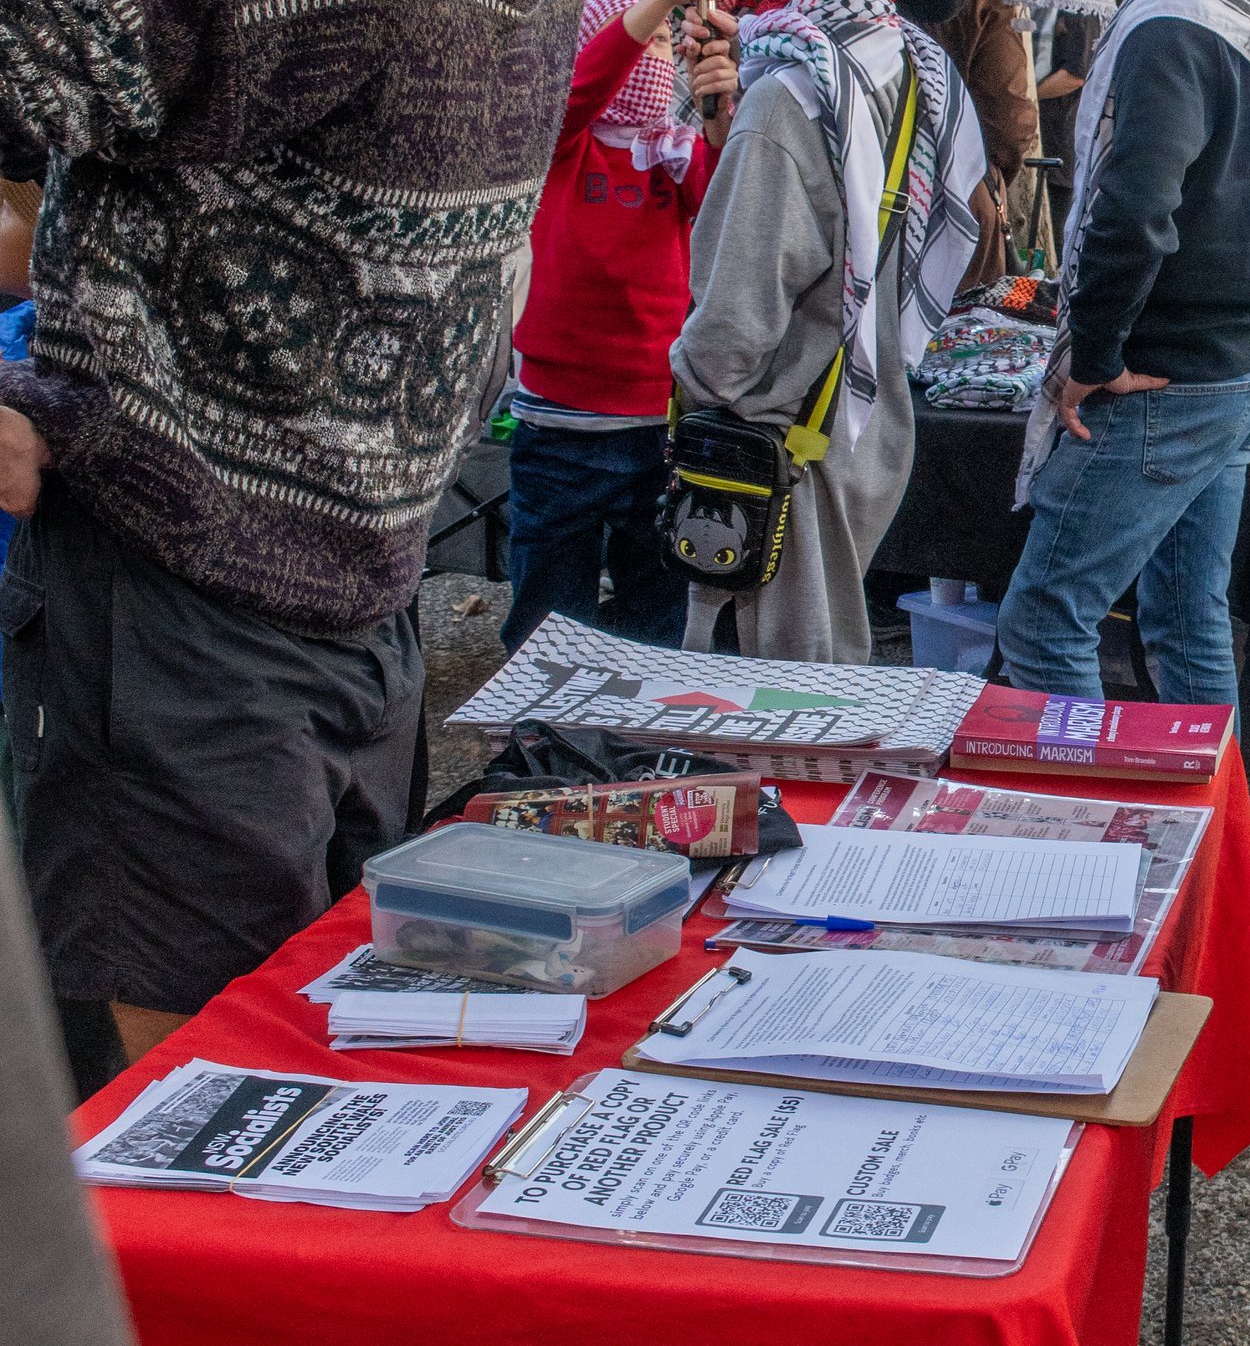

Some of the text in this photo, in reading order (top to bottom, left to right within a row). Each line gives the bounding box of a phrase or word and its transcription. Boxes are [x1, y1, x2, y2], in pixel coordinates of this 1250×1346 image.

[709, 719, 765, 738] THE
[775, 713, 836, 742] ISSUE
[1063, 702, 1106, 742] MARXISM
[966, 740, 1094, 764] INTRODUCING MARXISM
[661, 805, 672, 834] STUDENT
[669, 806, 680, 833] SPECIAL
[704, 1104, 727, 1122] Apple
[204, 1086, 303, 1170] Socialists
[271, 1113, 348, 1173] ANNOUNCING
[345, 1094, 371, 1112] THE
[282, 1154, 318, 1177] NEW
[310, 1122, 354, 1155] SOUTH
[349, 1092, 389, 1122] WALES
[317, 1107, 389, 1163] SOCIALISTS!
[514, 1078, 641, 1204] TO PURCHASE A COPY
[695, 1122, 716, 1140] using
[725, 1096, 805, 1186] RED FLAG SALE ($5)
[786, 1124, 807, 1137] Flag
[202, 1133, 232, 1154] NSW
[561, 1097, 657, 1192] OF RED FLAG OR
[583, 1092, 690, 1206] ANOTHER PRODUCT
[612, 1088, 717, 1218] simply scan on one of the QR code links
[672, 1141, 702, 1168] securely
[778, 1137, 795, 1148] Red
[871, 1114, 928, 1198] Buy badges, merch, books etc
[666, 1178, 694, 1202] Google
[700, 1153, 712, 1161] or
[711, 1126, 732, 1146] credit
[767, 1156, 786, 1170] copy
[846, 1129, 900, 1196] CUSTOM SALE
[1001, 1151, 1027, 1173] GPay
[662, 1170, 679, 1183] pay
[751, 1176, 773, 1188] Buy
[651, 1183, 667, 1198] and
[988, 1183, 1014, 1201] Pay
[629, 1199, 656, 1221] below
